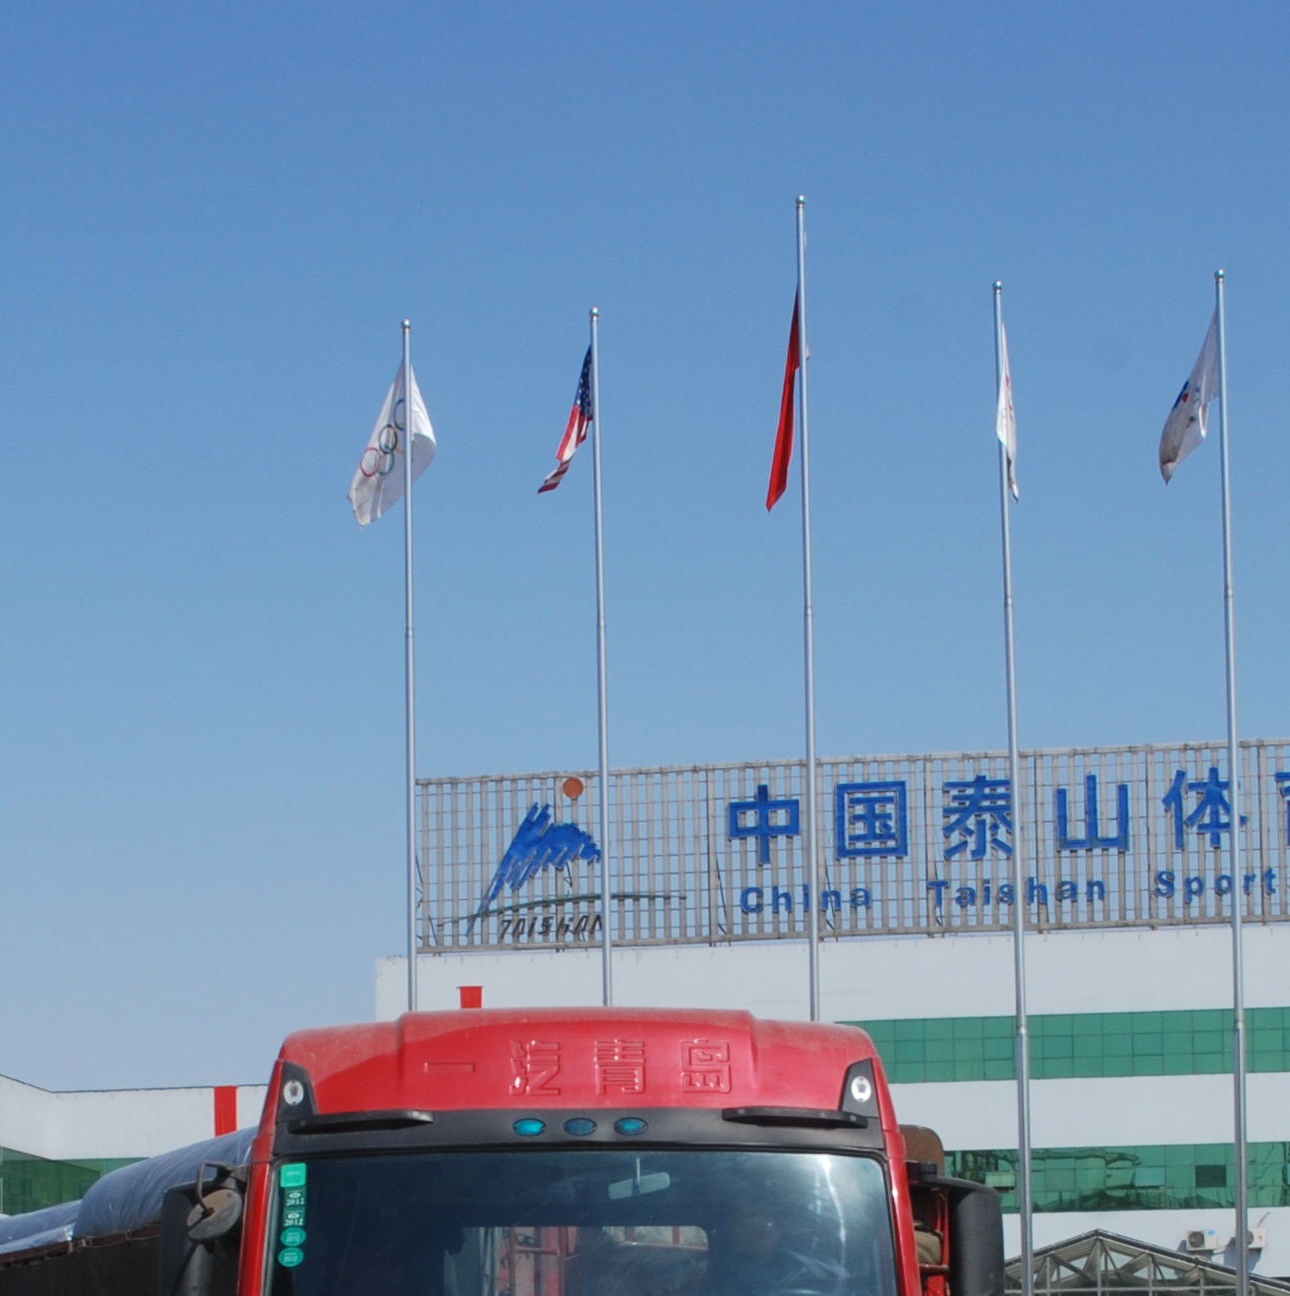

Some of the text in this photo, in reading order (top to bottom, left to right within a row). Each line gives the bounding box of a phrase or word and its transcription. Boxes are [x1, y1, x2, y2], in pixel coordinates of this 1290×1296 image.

[740, 884, 872, 914] China
[926, 876, 1106, 910] Taishan
[424, 1038, 732, 1097] 一汽青岛
